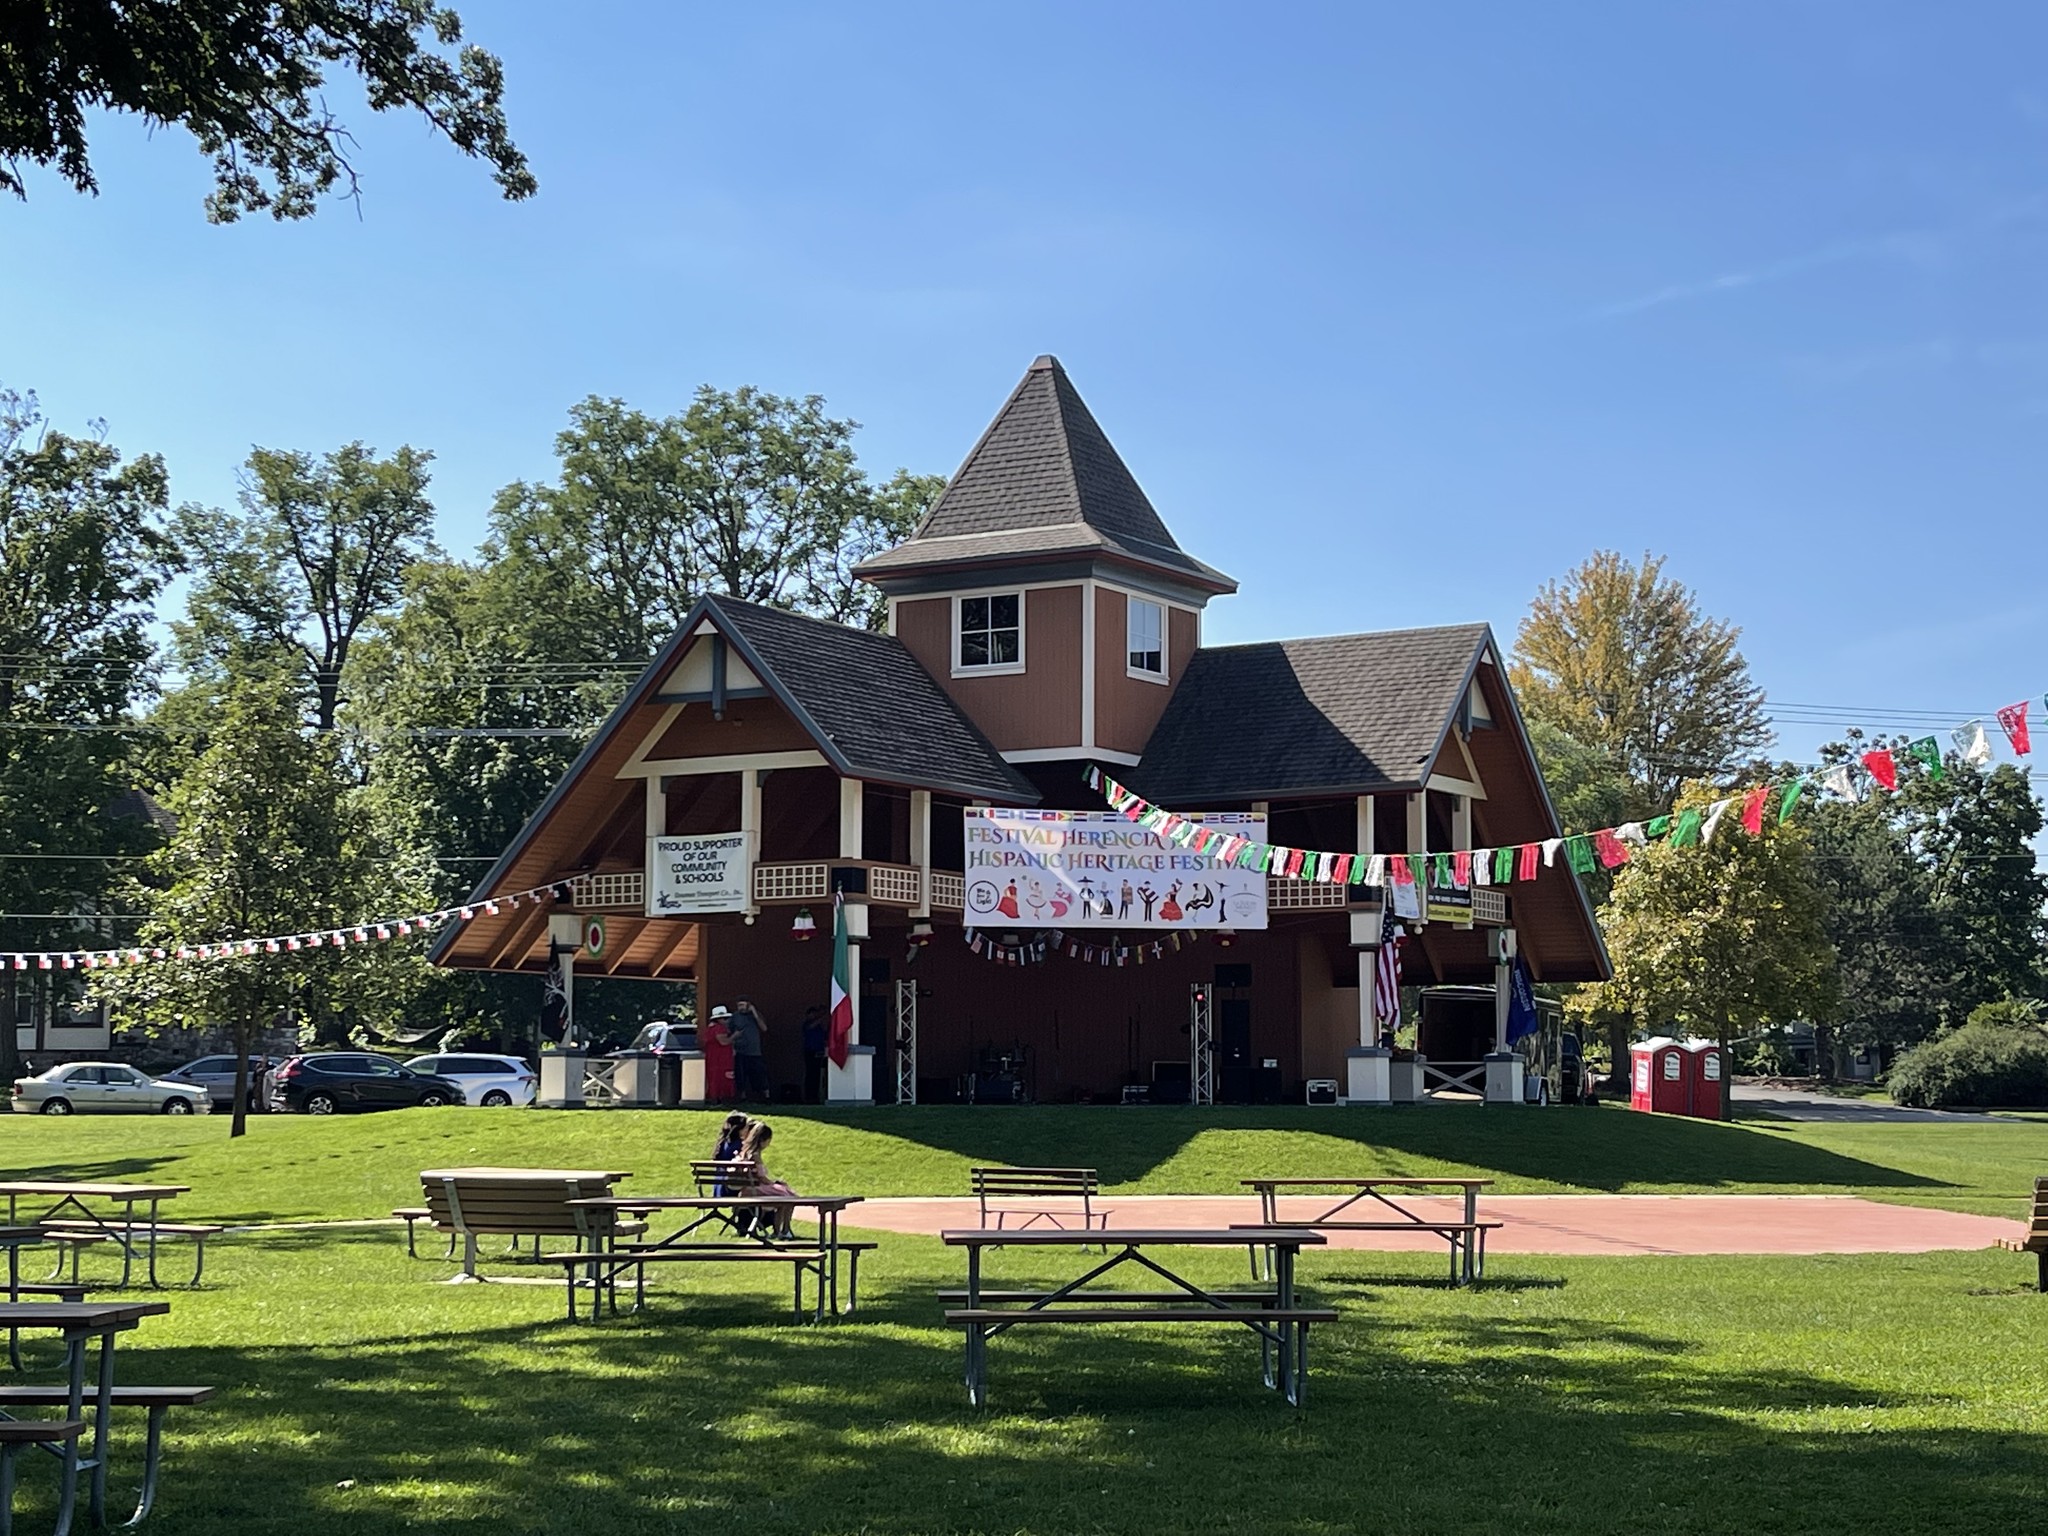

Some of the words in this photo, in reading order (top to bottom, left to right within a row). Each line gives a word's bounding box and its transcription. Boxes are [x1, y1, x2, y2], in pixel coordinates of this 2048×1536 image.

[968, 826, 1057, 844] FESTIVAL
[1062, 829, 1166, 849] HERENCIA
[658, 842, 692, 852] PROUD
[693, 838, 743, 850] SUPPORTER
[683, 852, 696, 861] OF
[698, 851, 718, 861] OUR
[968, 849, 1063, 870] HISPANIC
[1068, 851, 1164, 872] HERITAGE
[671, 861, 728, 873] COMMUNITY
[675, 874, 681, 884] &
[682, 872, 724, 884] SCHOOLS
